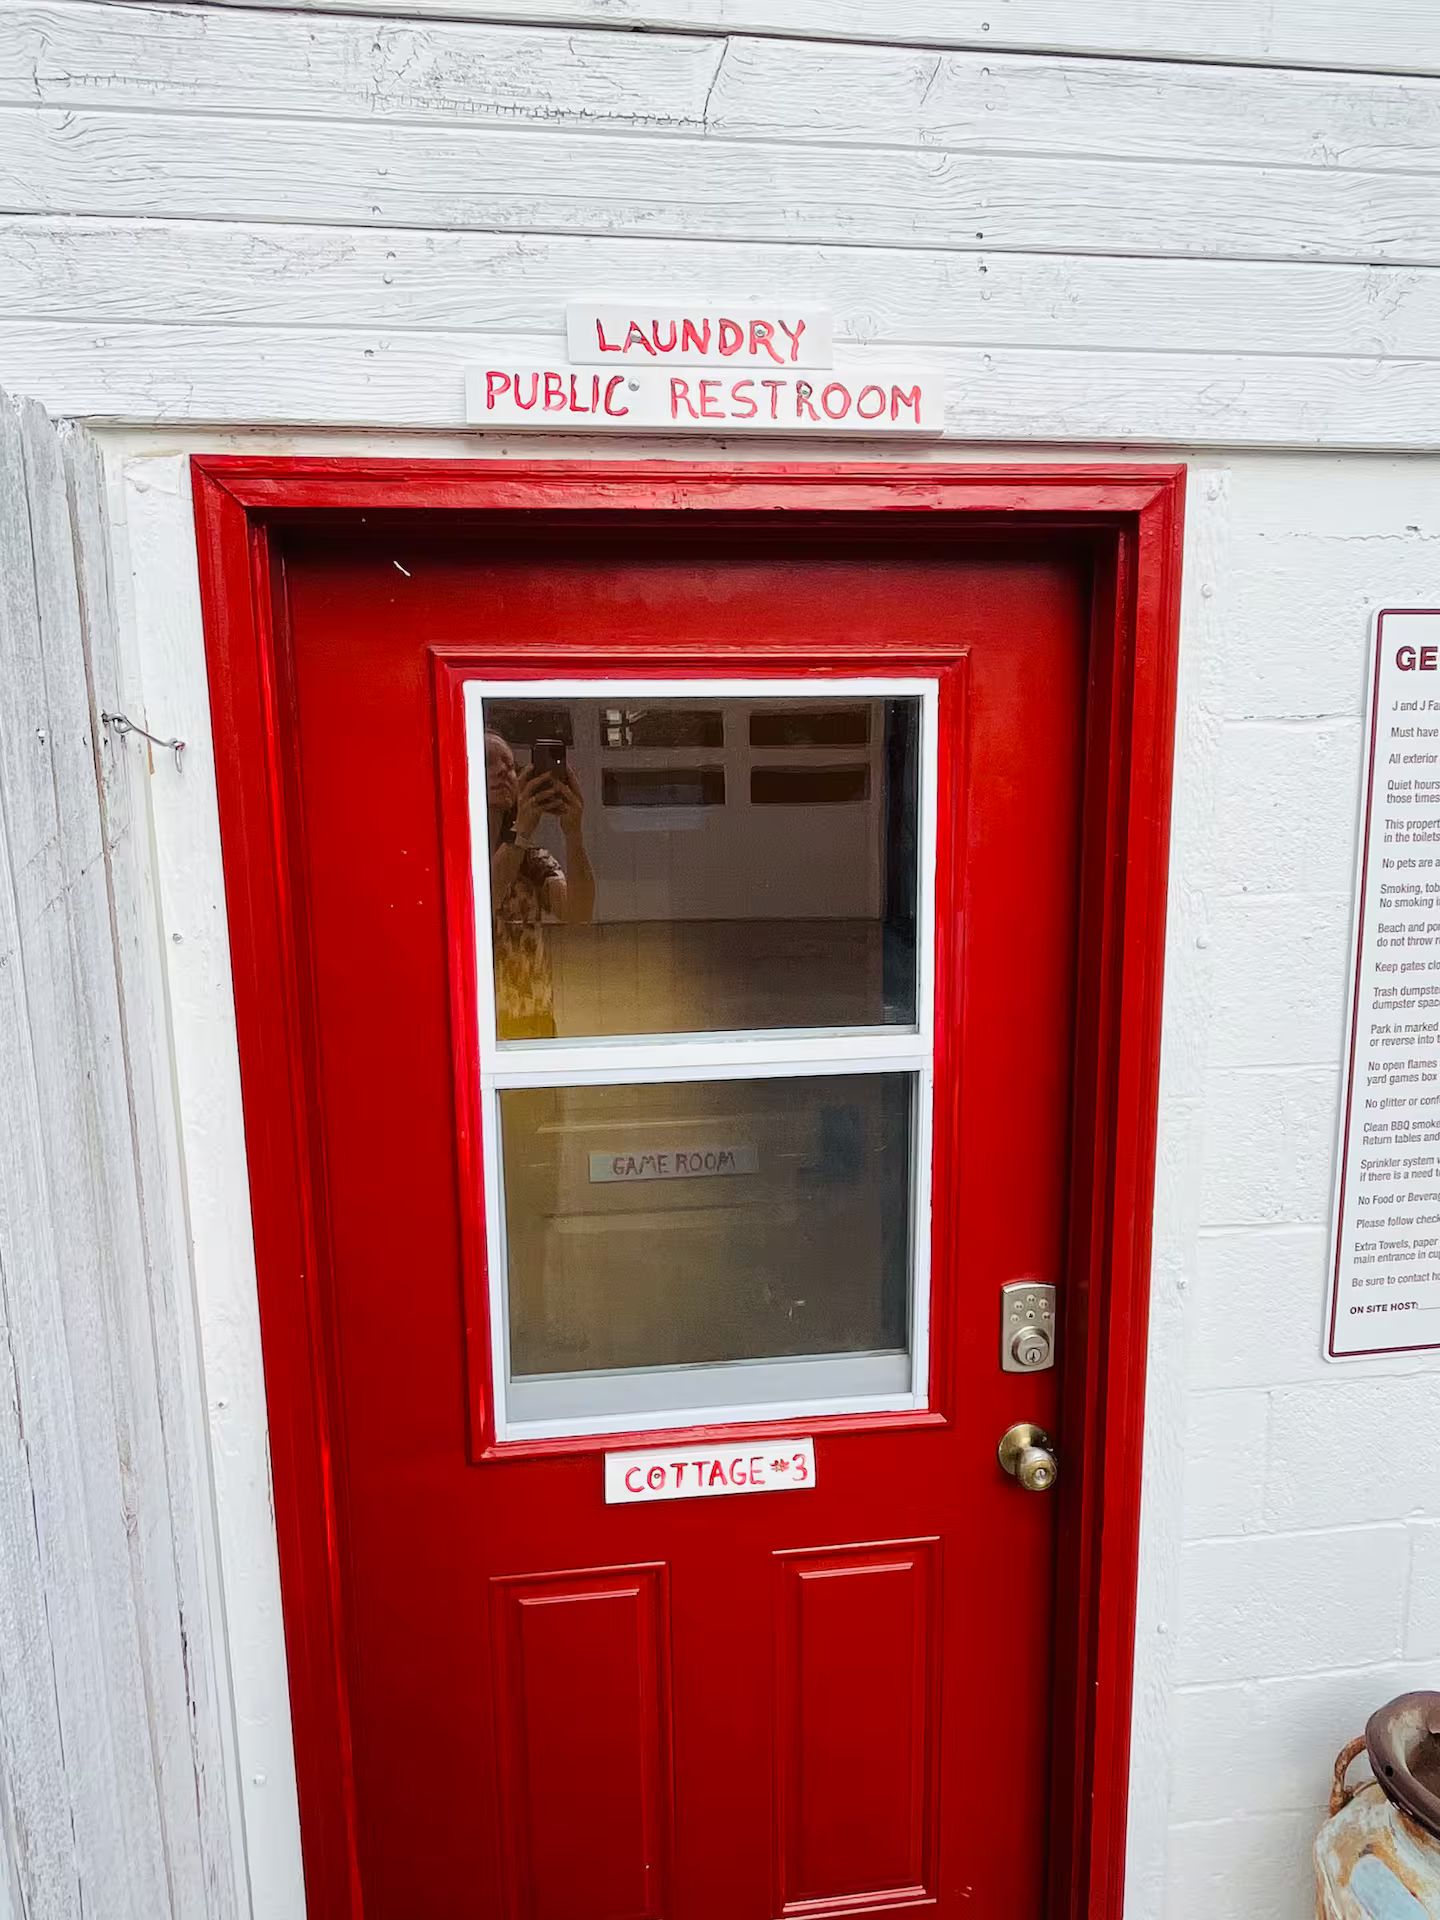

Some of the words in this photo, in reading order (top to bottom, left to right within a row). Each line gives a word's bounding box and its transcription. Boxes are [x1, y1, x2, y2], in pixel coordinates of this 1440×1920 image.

[596, 318, 806, 364] LAUNDRY
[486, 371, 629, 416] PUBLIC
[670, 377, 922, 424] RESTROOM
[1395, 645, 1438, 671] GE
[1392, 700, 1398, 711] J
[1400, 700, 1417, 711] and
[1420, 700, 1426, 711] J
[1391, 727, 1414, 738] Must
[1416, 727, 1439, 737] have
[1388, 753, 1401, 764] All
[1403, 753, 1438, 764] exterior
[1387, 780, 1412, 790] Quiet
[1386, 793, 1412, 804] those
[1385, 819, 1404, 830] This
[1384, 833, 1392, 843] in
[1395, 832, 1410, 843] the
[1412, 832, 1440, 842] toilets
[1382, 858, 1394, 868] No
[1396, 858, 1416, 870] pets
[1418, 859, 1433, 868] are
[1380, 898, 1392, 908] No
[1394, 897, 1433, 908] smoking
[1378, 923, 1405, 933] Beach
[1408, 922, 1425, 932] and
[1376, 937, 1388, 947] do
[1390, 937, 1404, 947] not
[1407, 936, 1433, 946] throw
[1375, 962, 1398, 973] Keep
[1400, 961, 1425, 973] gates
[1373, 986, 1397, 997] Trash
[1372, 999, 1415, 1010] dumpster
[1371, 1024, 1391, 1034] Park
[1393, 1023, 1402, 1033] in
[1404, 1022, 1438, 1033] marked
[1370, 1038, 1378, 1047] or
[1381, 1037, 1415, 1046] reverse
[1417, 1034, 1434, 1044] into
[1368, 1061, 1380, 1071] No
[1382, 1061, 1405, 1072] open
[1407, 1059, 1437, 1069] flames
[1367, 1074, 1387, 1086] yard
[1389, 1074, 1419, 1085] games
[1421, 1073, 1437, 1082] box
[1365, 1099, 1377, 1109] No
[1379, 1098, 1407, 1110] glitter
[1408, 1098, 1417, 1106] or
[1363, 1122, 1388, 1132] Clean
[1391, 1120, 1410, 1131] BBQ
[1362, 1135, 1392, 1145] Return
[1395, 1133, 1421, 1144] tables
[612, 1154, 669, 1176] GAME
[675, 1151, 736, 1174] ROOM
[1360, 1158, 1400, 1170] Sprinkler
[1403, 1156, 1434, 1168] system
[1360, 1172, 1366, 1182] if
[1368, 1172, 1391, 1181] there
[1394, 1170, 1401, 1180] is
[1403, 1171, 1409, 1179] a
[1411, 1168, 1433, 1179] need
[1358, 1196, 1370, 1205] No
[1373, 1194, 1394, 1204] Food
[1356, 1219, 1385, 1229] Please
[1388, 1216, 1414, 1226] follow
[1354, 1242, 1377, 1252] Extra
[1379, 1240, 1411, 1249] Towels,
[1413, 1239, 1438, 1249] paper
[1353, 1254, 1375, 1264] main
[1377, 1253, 1415, 1263] entrance
[1418, 1250, 1426, 1259] in
[1352, 1278, 1363, 1287] Be
[1365, 1277, 1385, 1286] sure
[1387, 1276, 1395, 1285] to
[1398, 1273, 1429, 1284] contact
[1350, 1306, 1364, 1315] ON
[1366, 1304, 1387, 1313] SITE
[1390, 1301, 1419, 1311] HOST:
[625, 1456, 766, 1493] COTTAGE
